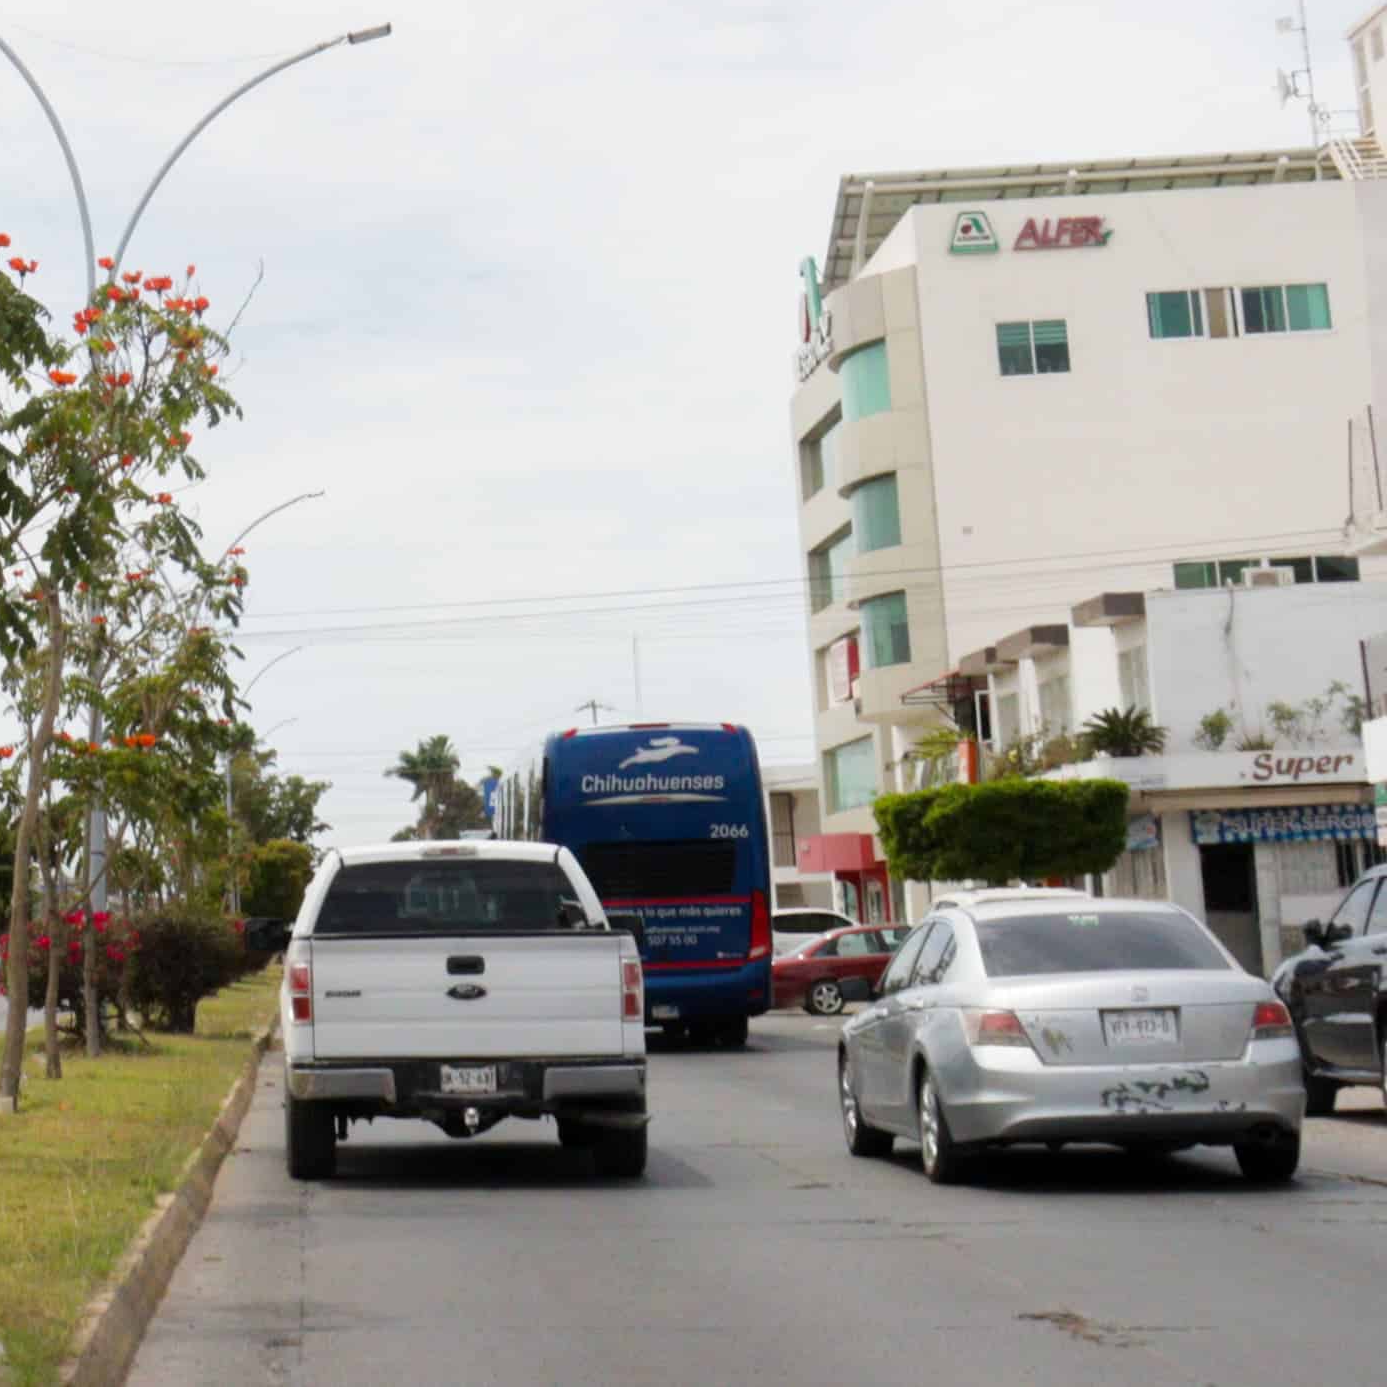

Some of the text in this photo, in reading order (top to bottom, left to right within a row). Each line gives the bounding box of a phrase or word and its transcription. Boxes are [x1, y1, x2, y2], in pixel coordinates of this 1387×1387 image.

[1013, 216, 1109, 251] ALFER
[1252, 752, 1354, 781] Super
[581, 774, 725, 793] Chihuahuenses
[709, 824, 749, 839] 2066
[1232, 815, 1296, 832] SUPER
